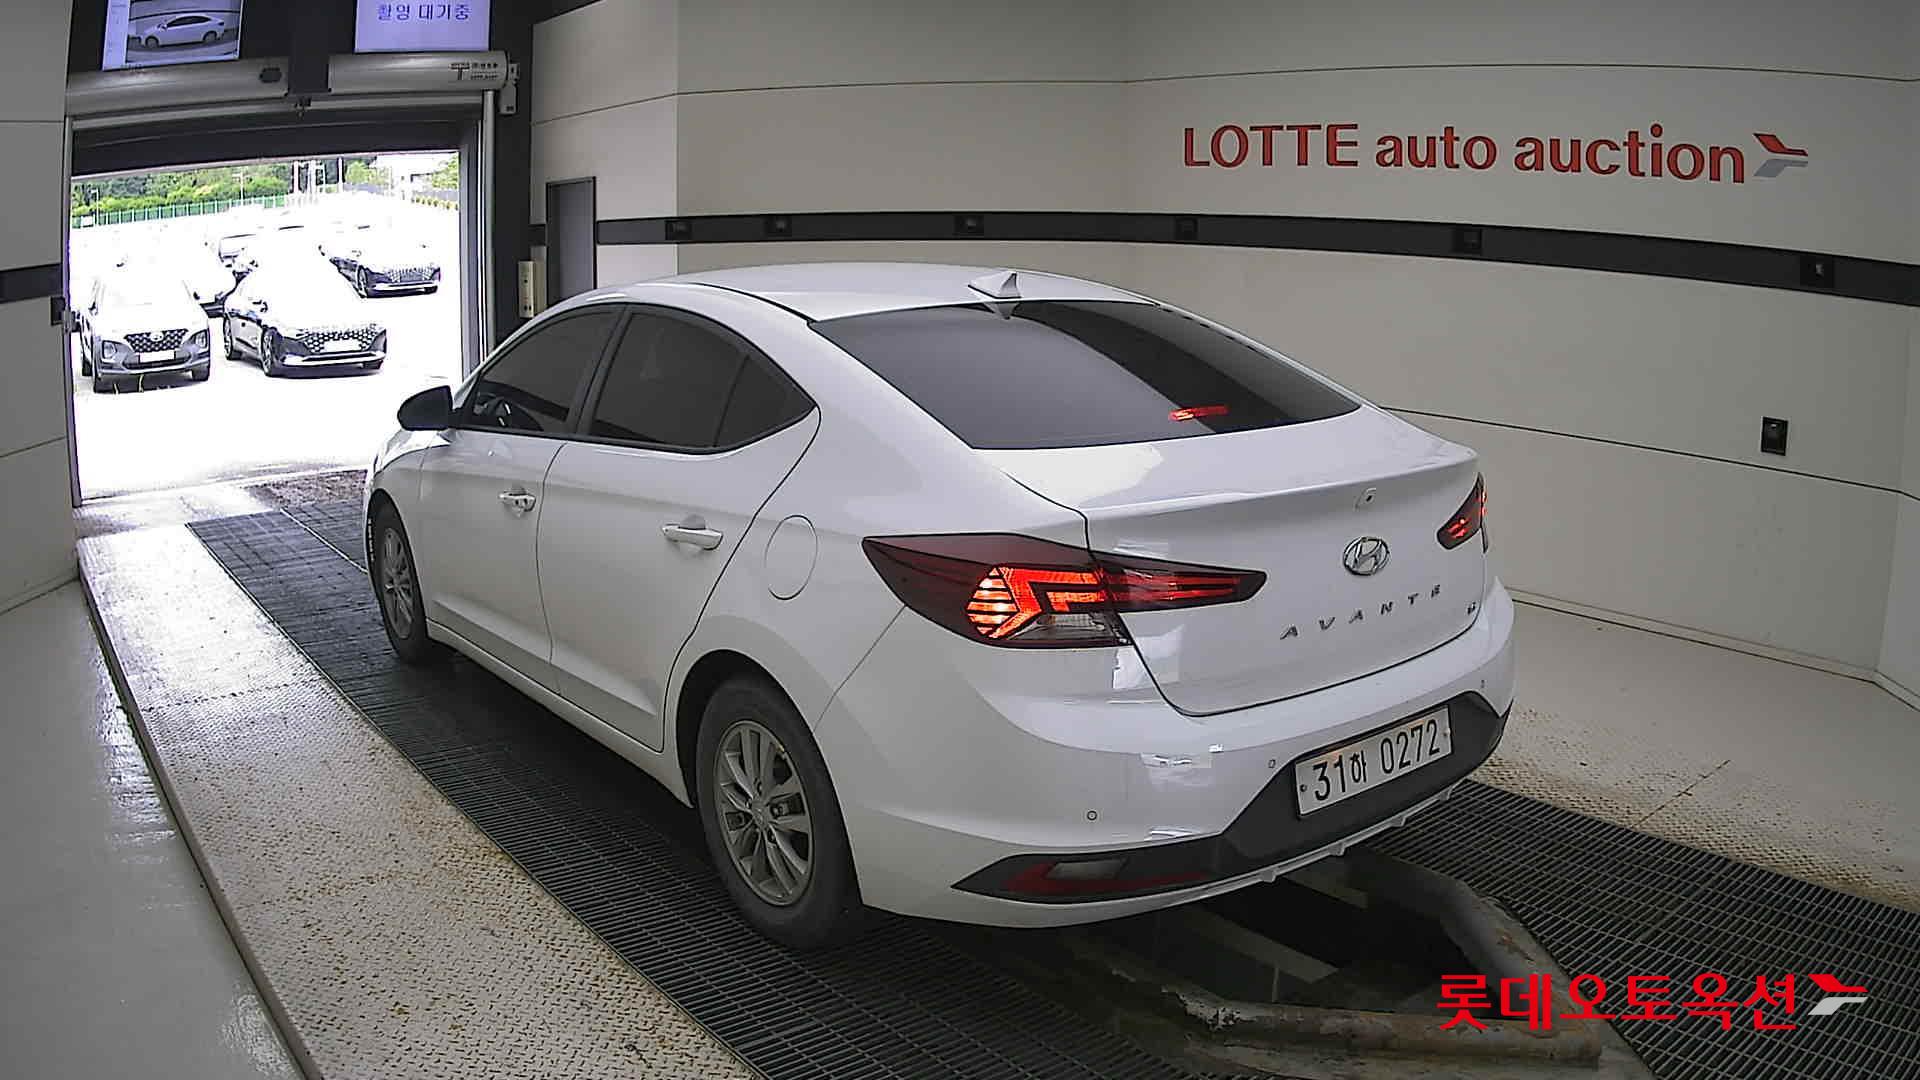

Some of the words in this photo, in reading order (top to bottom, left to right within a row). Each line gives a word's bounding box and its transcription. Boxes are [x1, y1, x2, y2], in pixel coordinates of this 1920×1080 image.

[418, 3, 472, 20] 대기중
[1184, 123, 1360, 168] LOTTE
[1375, 126, 1498, 170] auto
[1513, 124, 1746, 185] auction
[1280, 584, 1442, 640] AVANTE
[1312, 750, 1367, 801] 31하
[1380, 719, 1440, 774] 0272
